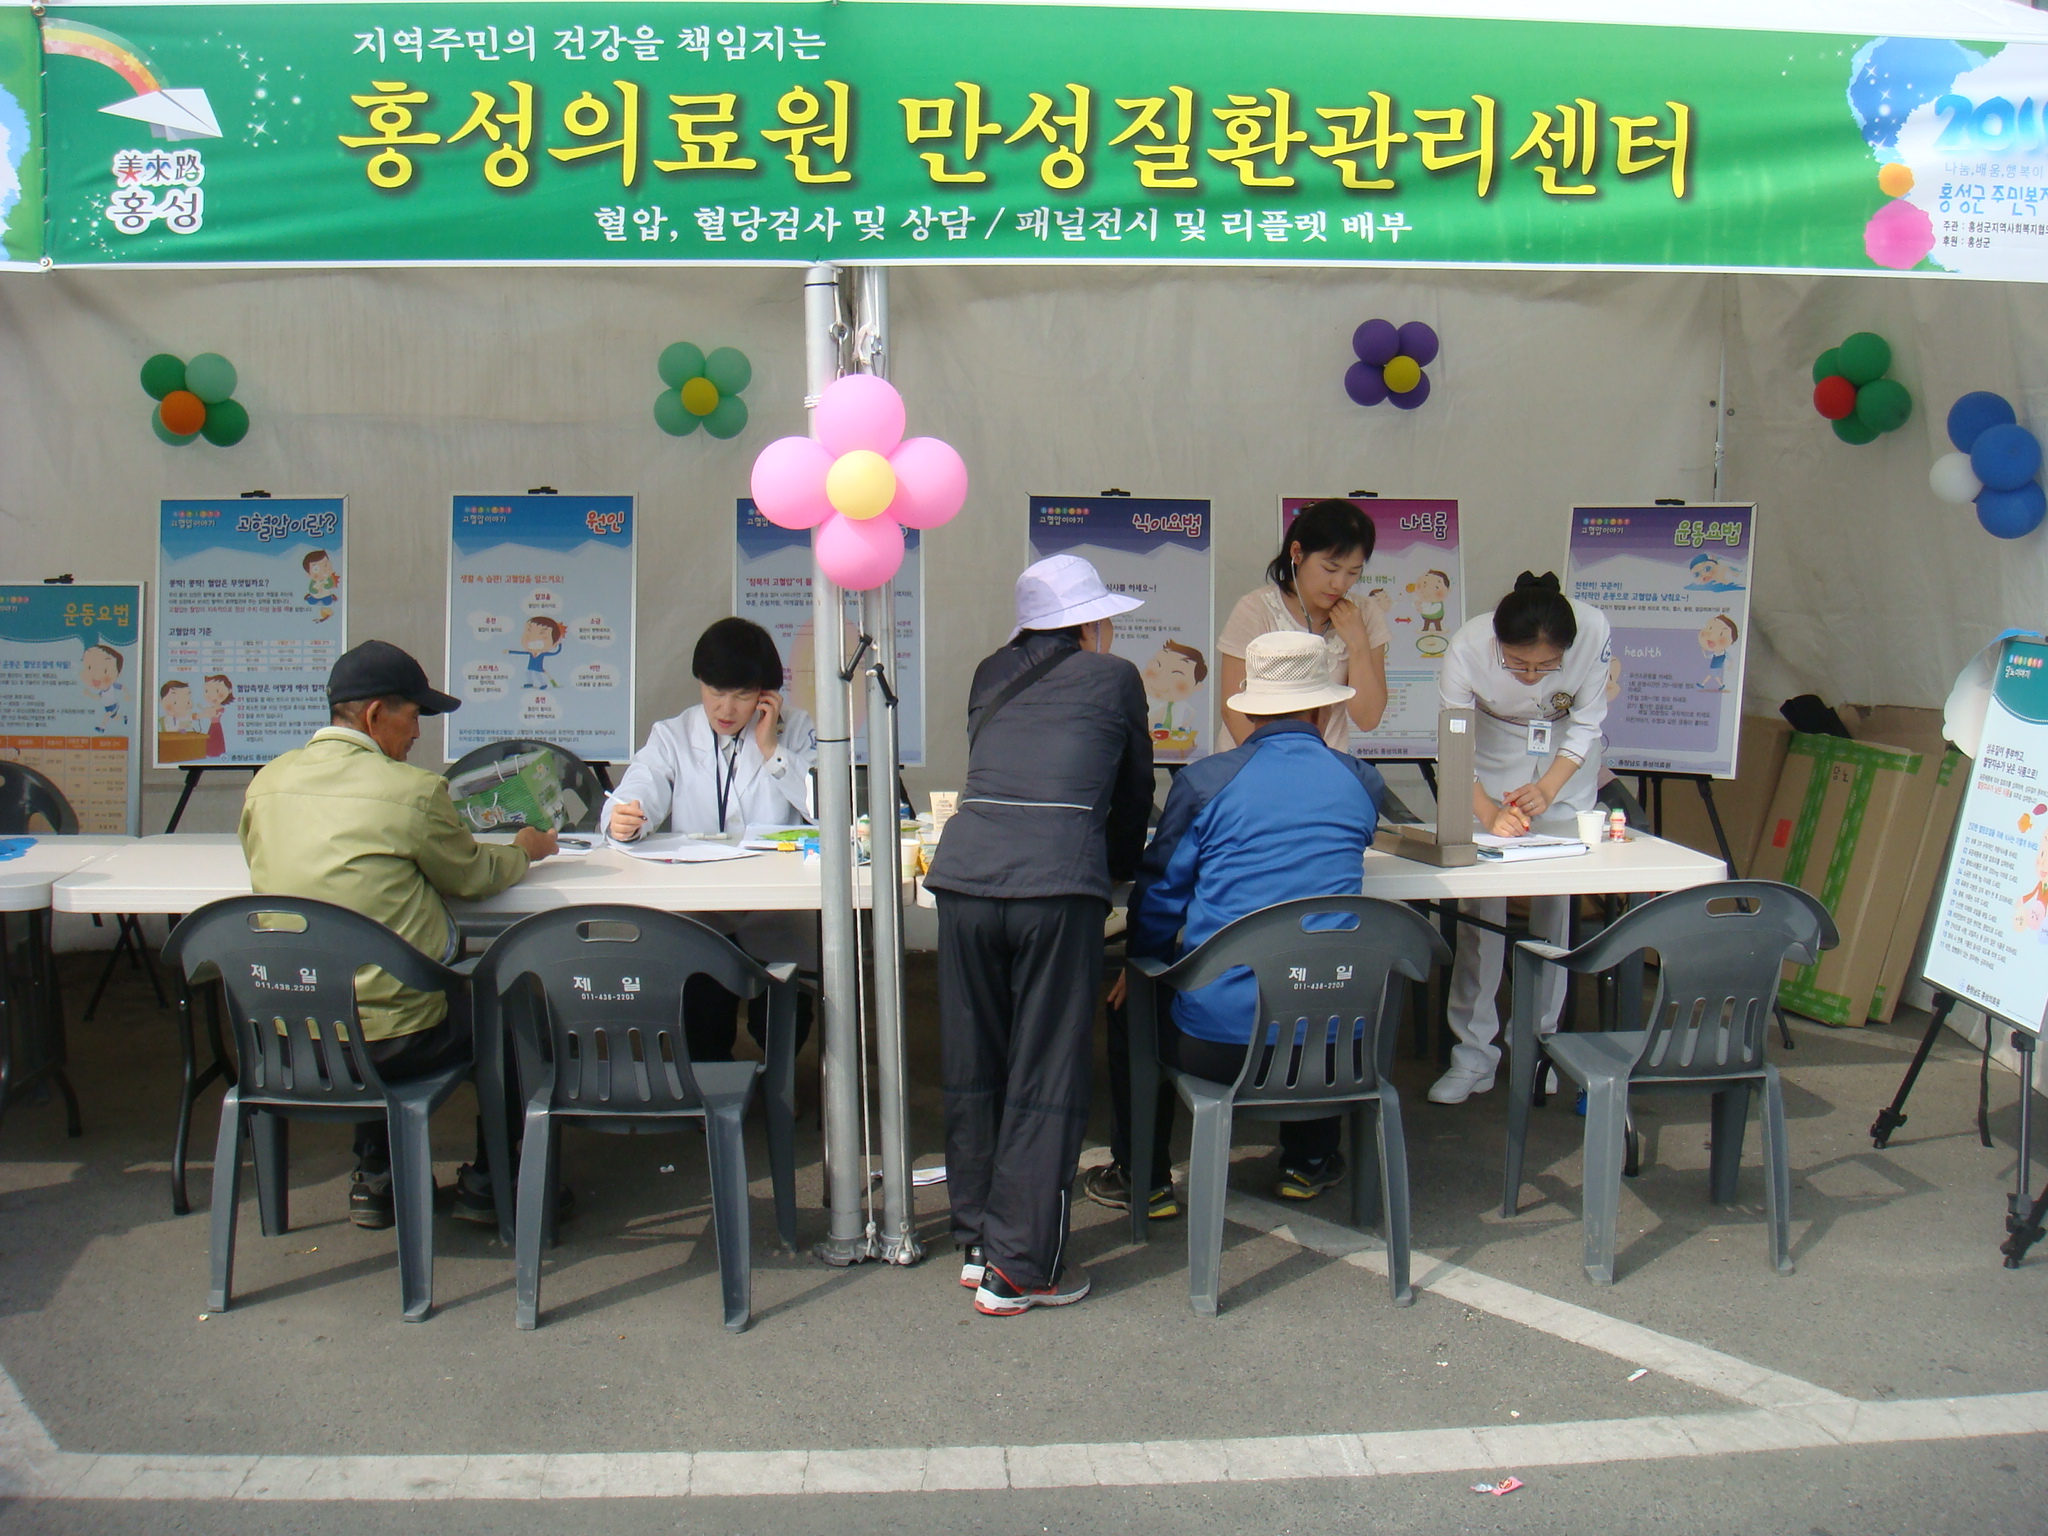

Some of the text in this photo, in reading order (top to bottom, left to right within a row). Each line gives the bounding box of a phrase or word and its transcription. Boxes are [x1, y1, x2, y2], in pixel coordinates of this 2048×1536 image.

[353, 25, 826, 62] 지역주민의 건강을 책임지는
[1933, 94, 2048, 151] 201
[339, 79, 1694, 200] 홍성의료원 만성질환관리센터
[1939, 183, 1985, 214] 홍성군
[113, 192, 197, 228] 홍성
[595, 205, 679, 244] 혈압,
[695, 206, 841, 242] 혈당검사
[853, 206, 885, 240] 및
[901, 207, 975, 243] 상담
[1015, 207, 1159, 243] 패널전시
[1176, 208, 1207, 242] 및
[1221, 209, 1328, 243] 리플렛
[1342, 211, 1413, 244] 배부
[1943, 221, 1958, 232] 주관
[1943, 236, 1957, 247] 후원
[1967, 237, 1990, 248] 홍성군
[171, 519, 215, 529] 고혈압이야기
[237, 512, 337, 542] 고혈압이란?
[463, 515, 506, 525] 고혈압이야기
[586, 510, 624, 534] 원인
[747, 517, 771, 527] 고혈압
[1039, 515, 1083, 525] 고혈압이야기
[1132, 513, 1202, 537] 식이요법
[1400, 511, 1447, 540] 나트륨
[1581, 526, 1623, 536] 고혈압이야기
[1674, 520, 1743, 547] 운동요법
[1575, 582, 1622, 590] 천천히! 꾸준히!
[1574, 592, 1600, 600] 규칙적인
[1603, 592, 1628, 601] 운동으로
[1632, 593, 1658, 601] 고혈압을
[64, 603, 129, 627] 운동요법
[169, 628, 212, 636] 고혈압의 기준
[1625, 646, 1661, 658] health
[273, 684, 292, 693] 어떻게
[312, 684, 327, 692] 할까
[251, 964, 317, 984] 제 일
[1289, 965, 1353, 982] 제 일
[573, 976, 640, 993] 제 일
